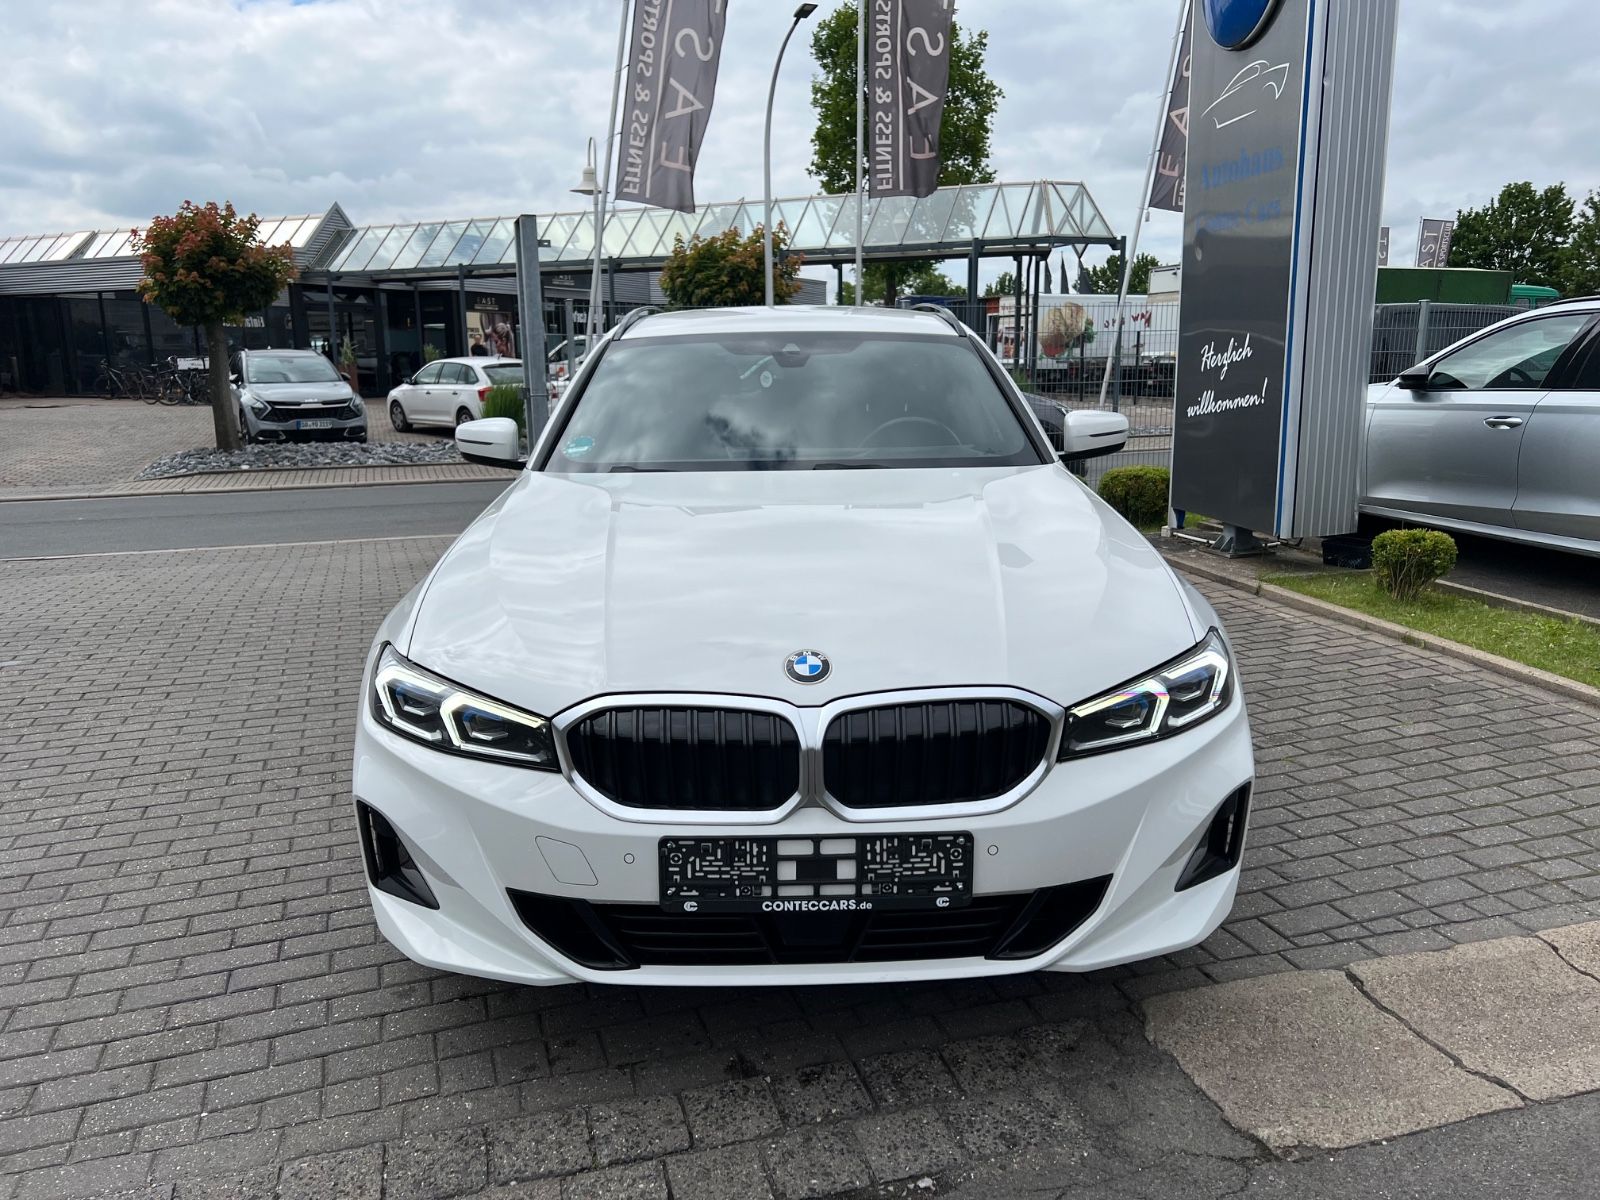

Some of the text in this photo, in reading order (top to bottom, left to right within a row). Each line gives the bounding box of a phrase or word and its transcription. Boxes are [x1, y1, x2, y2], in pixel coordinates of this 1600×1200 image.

[1201, 333, 1253, 380] Herzlich
[1187, 377, 1268, 417] willkommen!
[762, 899, 872, 912] CONTECCARS.de
